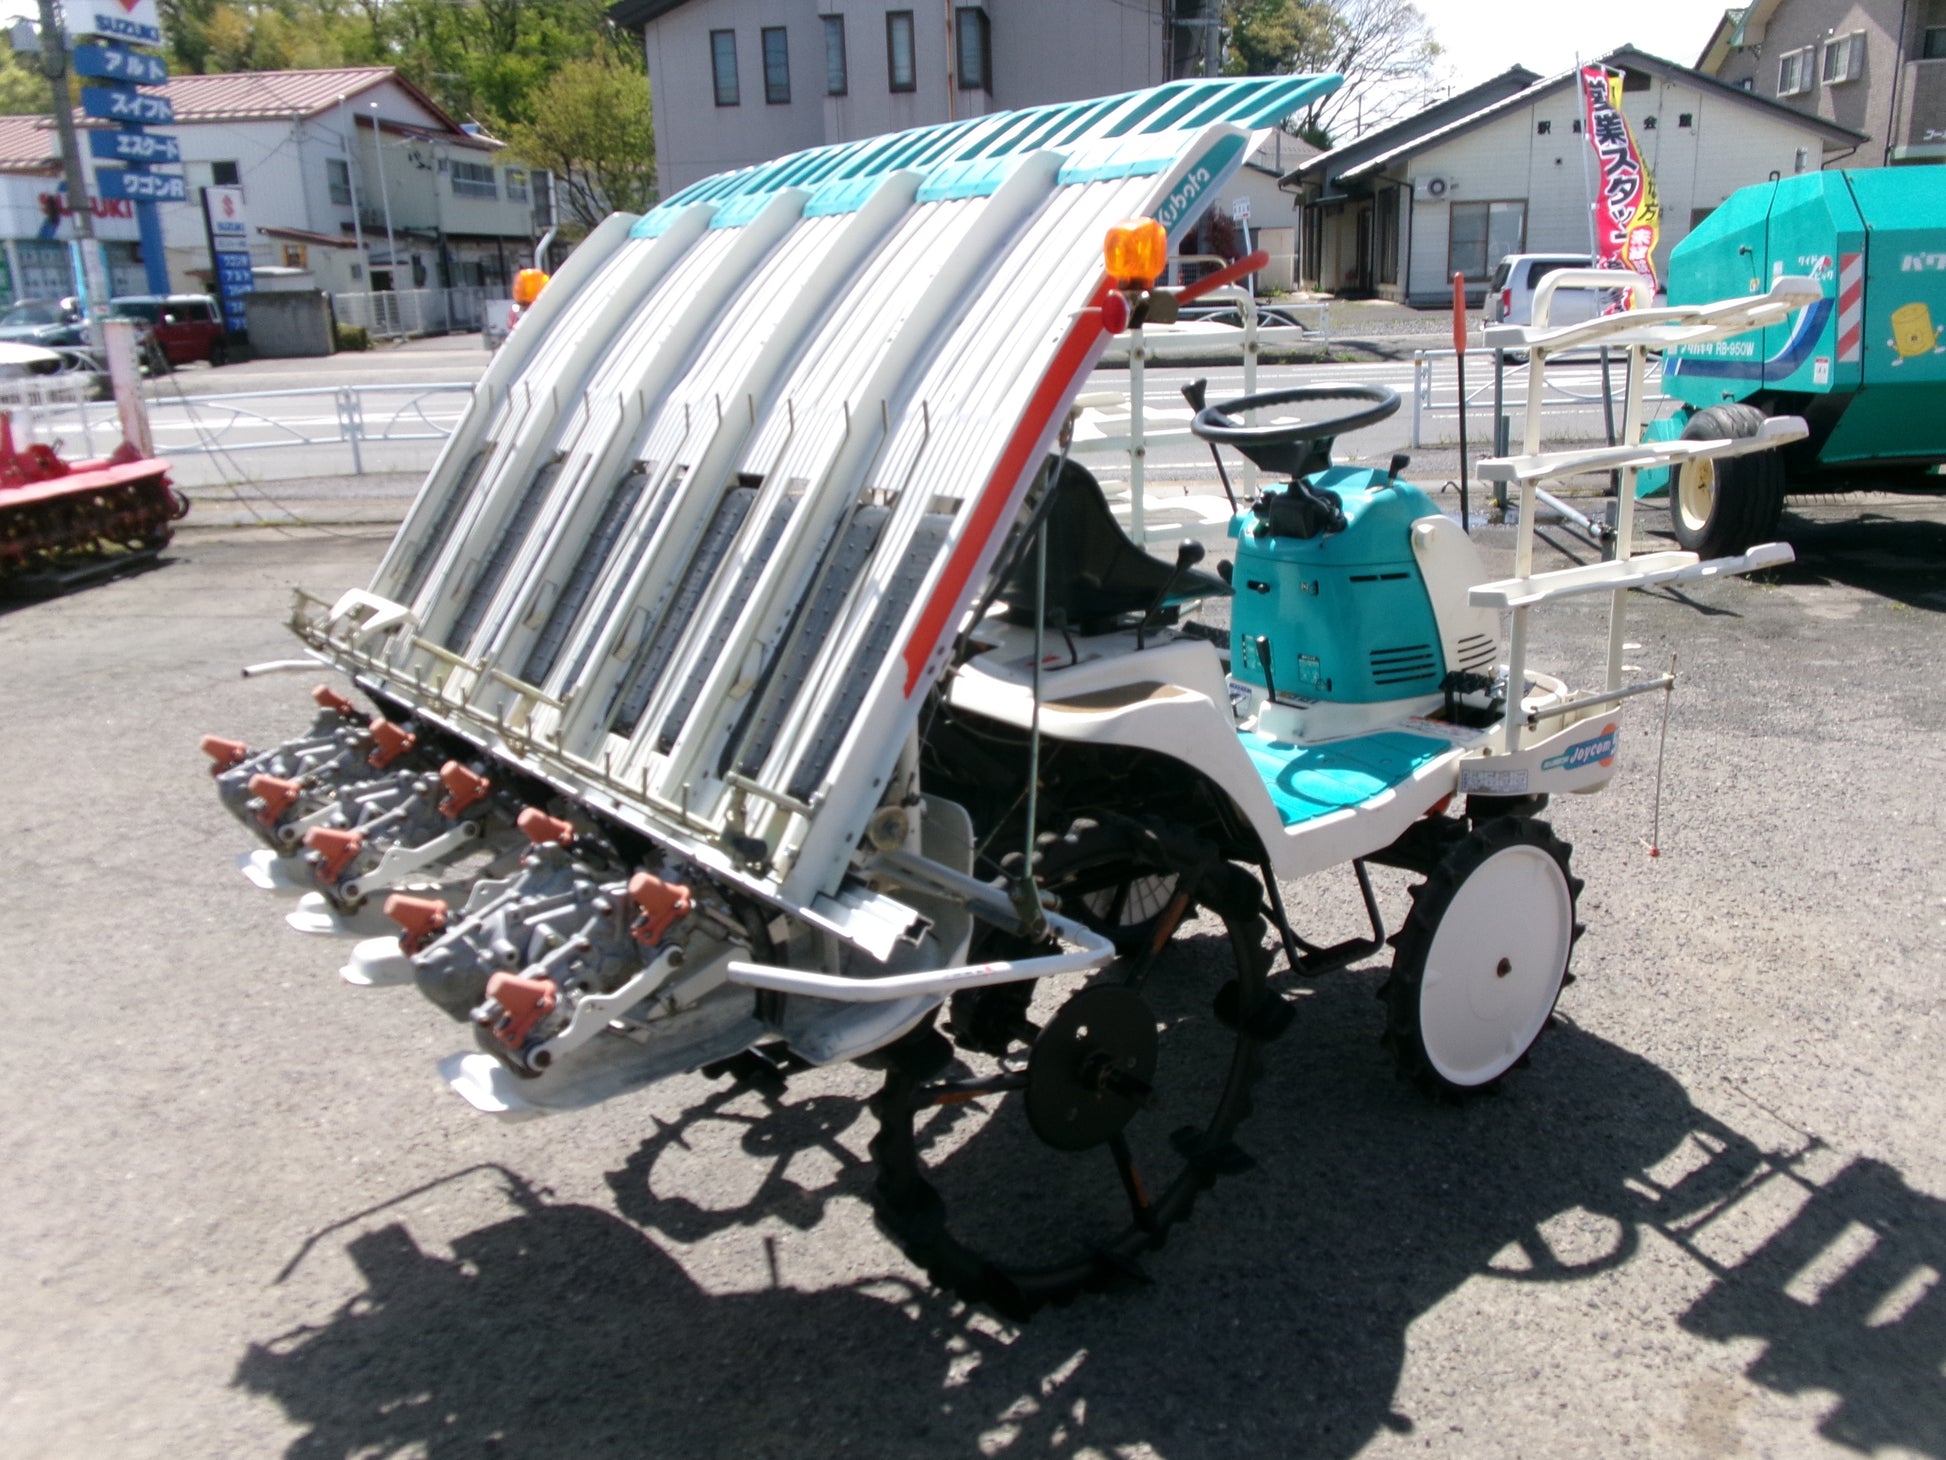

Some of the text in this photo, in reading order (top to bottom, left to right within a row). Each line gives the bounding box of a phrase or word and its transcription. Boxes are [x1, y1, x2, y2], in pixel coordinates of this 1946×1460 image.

[94, 14, 160, 42] SUZUKI
[105, 51, 166, 79] アルト
[111, 92, 171, 119] スイフト
[117, 134, 179, 157] エスクード
[123, 174, 185, 198] ワゴンR
[1159, 167, 1211, 227] Kubota
[1569, 740, 1612, 764] Joycom
